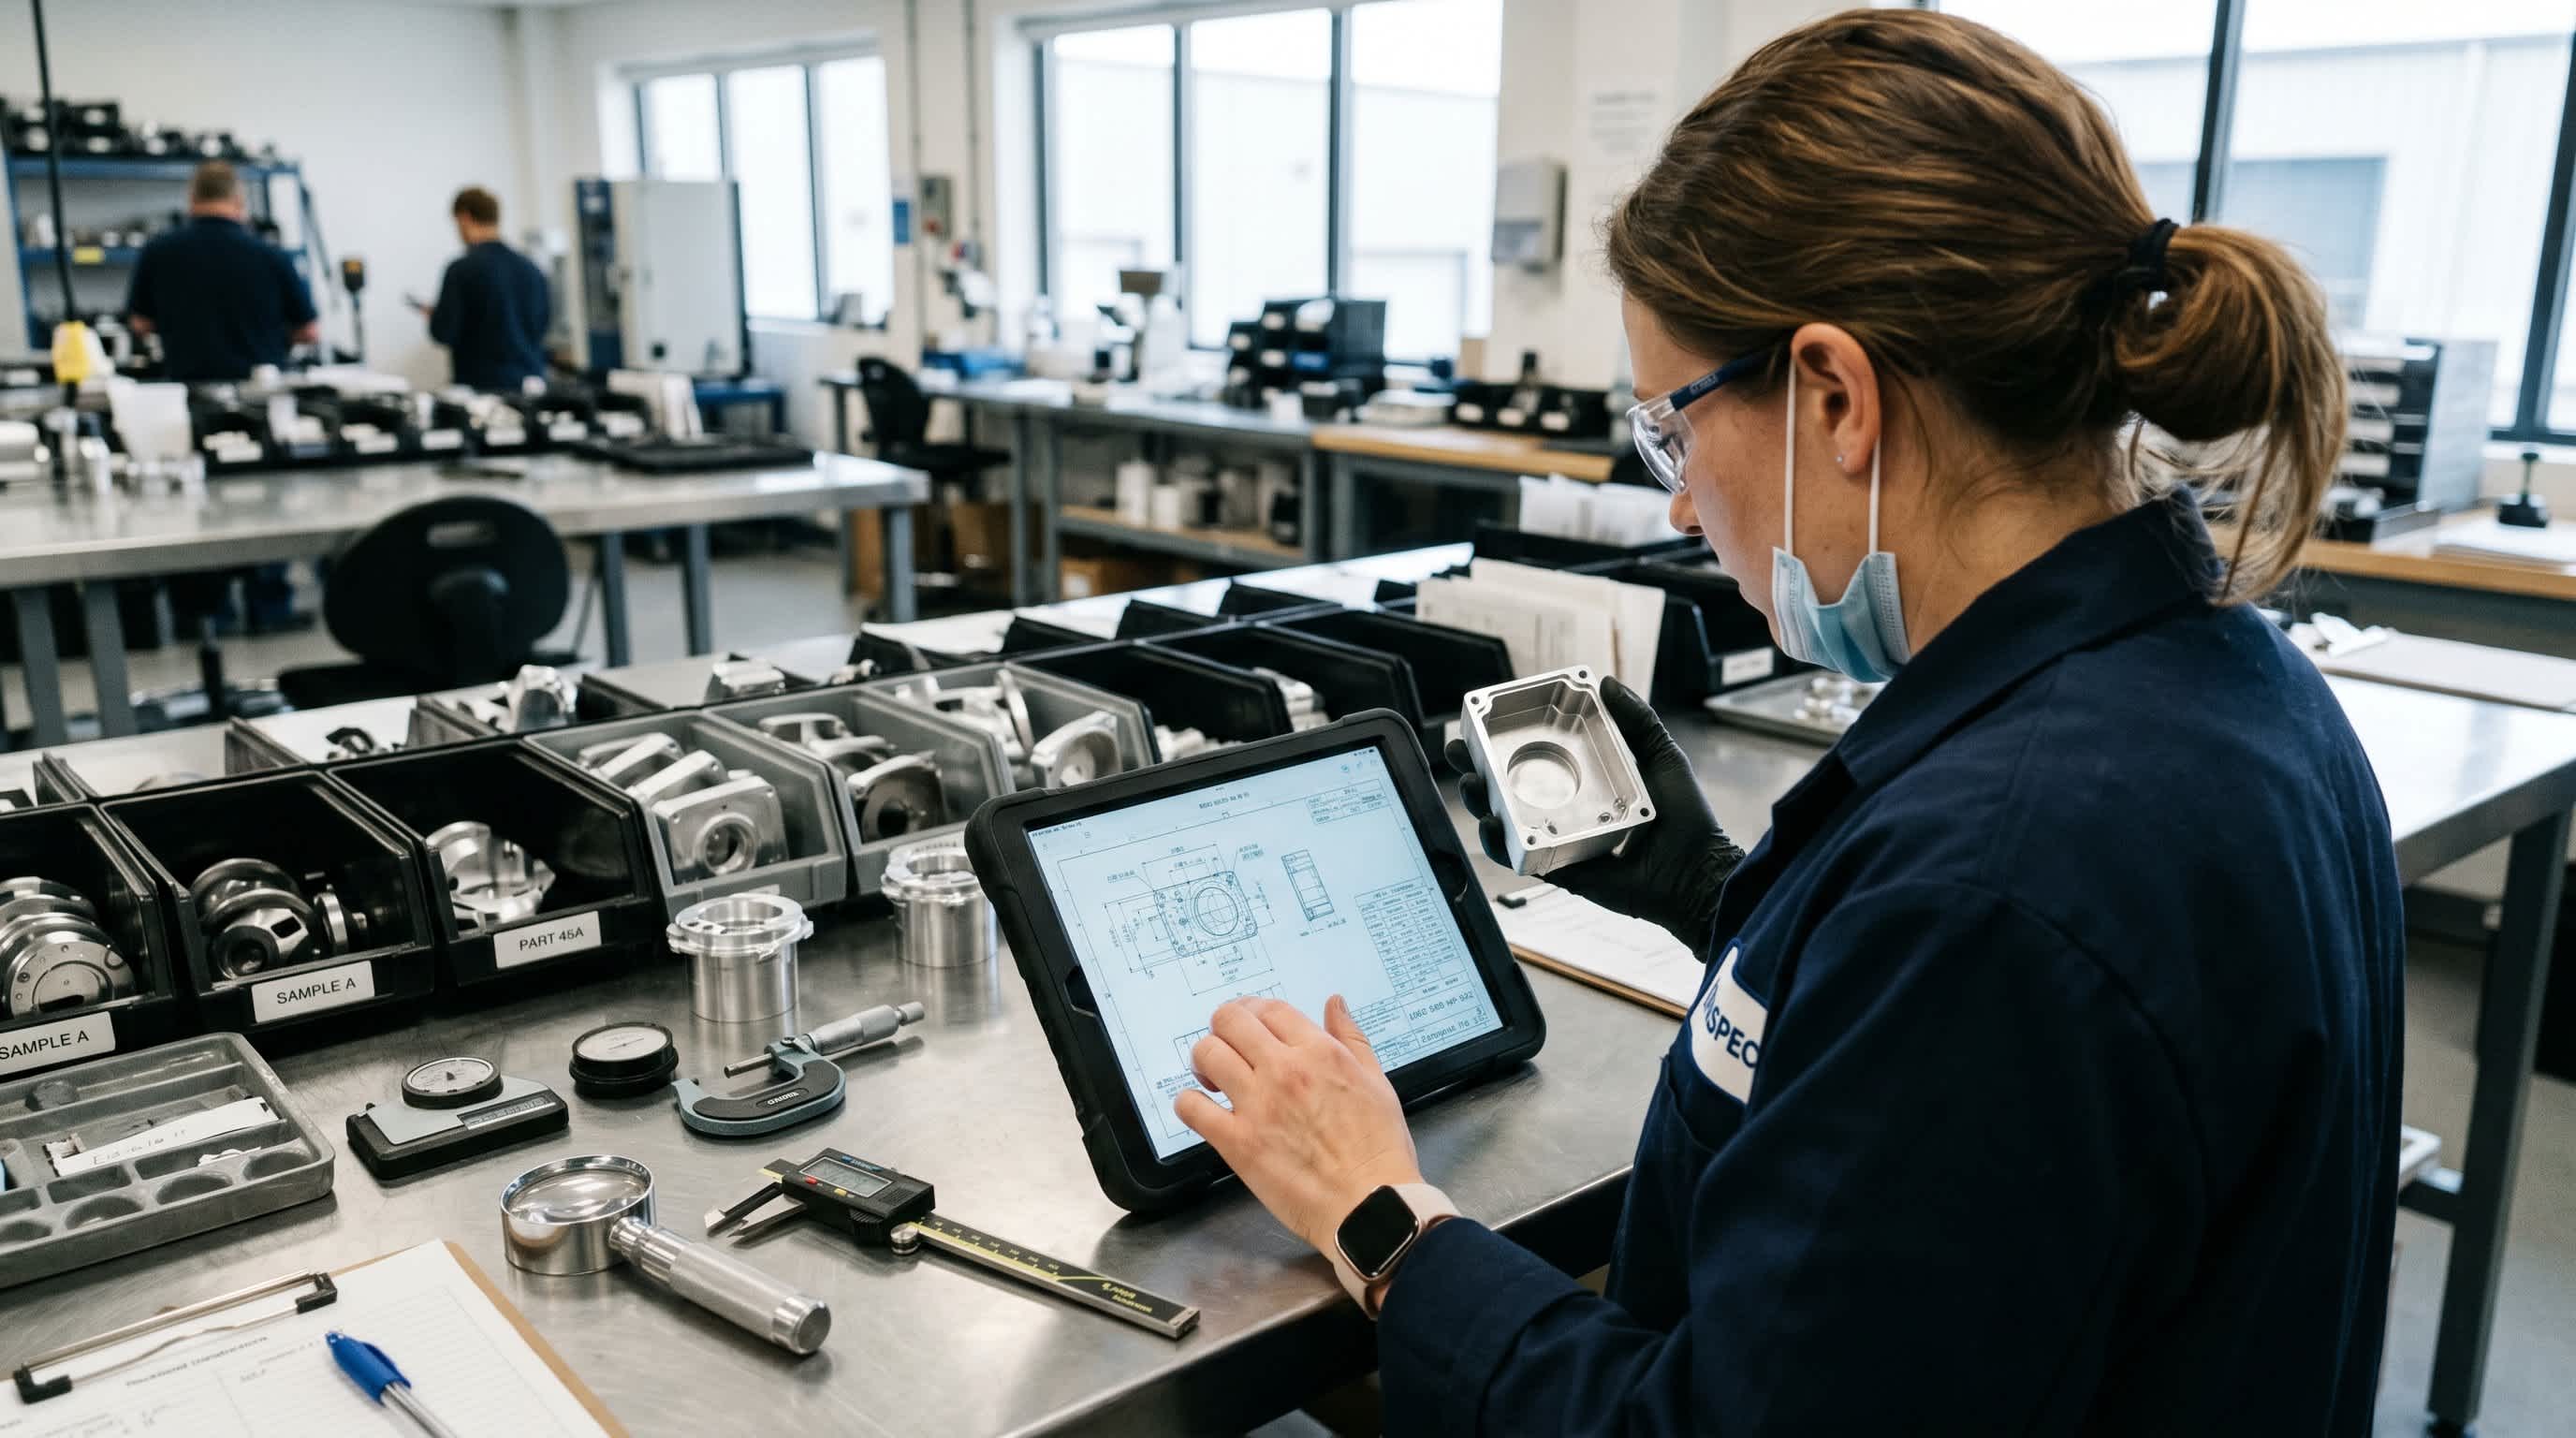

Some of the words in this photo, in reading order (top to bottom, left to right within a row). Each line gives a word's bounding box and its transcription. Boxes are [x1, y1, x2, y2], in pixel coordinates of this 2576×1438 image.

[520, 932, 554, 951] PART
[276, 979, 341, 1005] SAMPLE
[345, 977, 357, 990] A
[0, 1033, 72, 1060] SAMPLE
[77, 1030, 90, 1044] A
